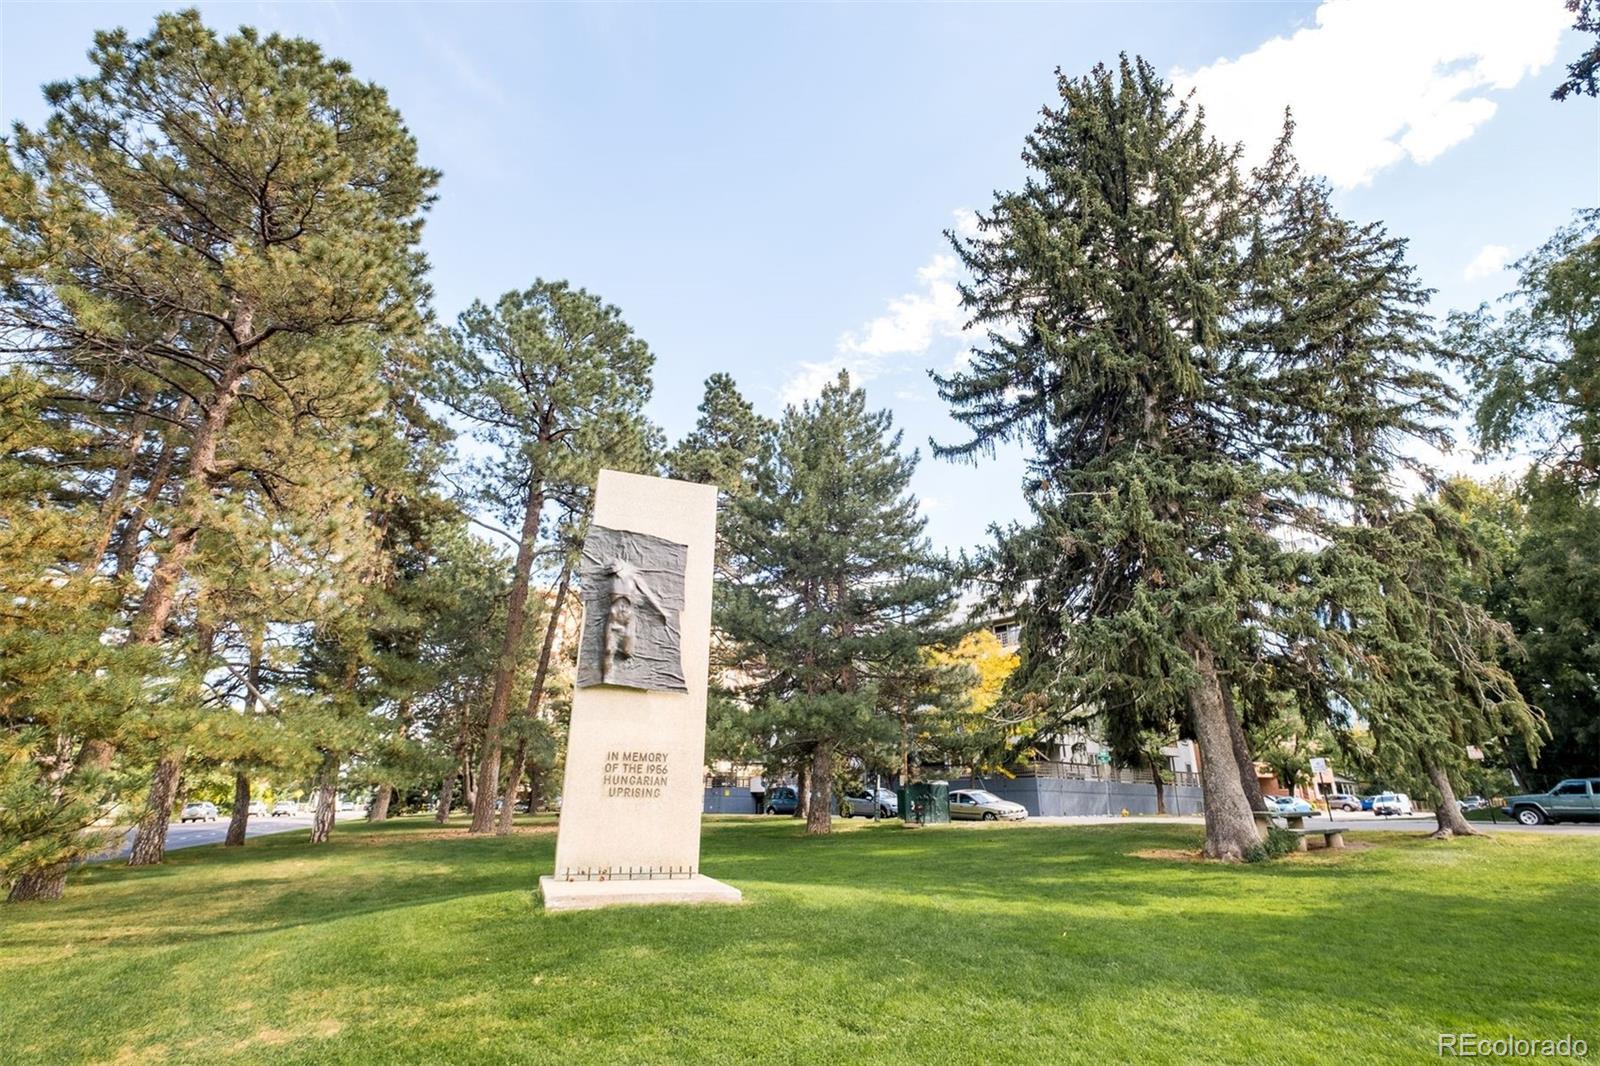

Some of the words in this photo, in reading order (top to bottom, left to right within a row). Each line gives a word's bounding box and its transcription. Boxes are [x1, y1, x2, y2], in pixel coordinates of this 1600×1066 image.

[607, 751, 619, 761] IN
[623, 752, 669, 762] MEMORY
[604, 763, 619, 773] OF
[622, 763, 643, 774] THE
[646, 764, 668, 775] 1956
[603, 775, 668, 786] HUNGARIAN
[608, 787, 661, 798] UPRISING
